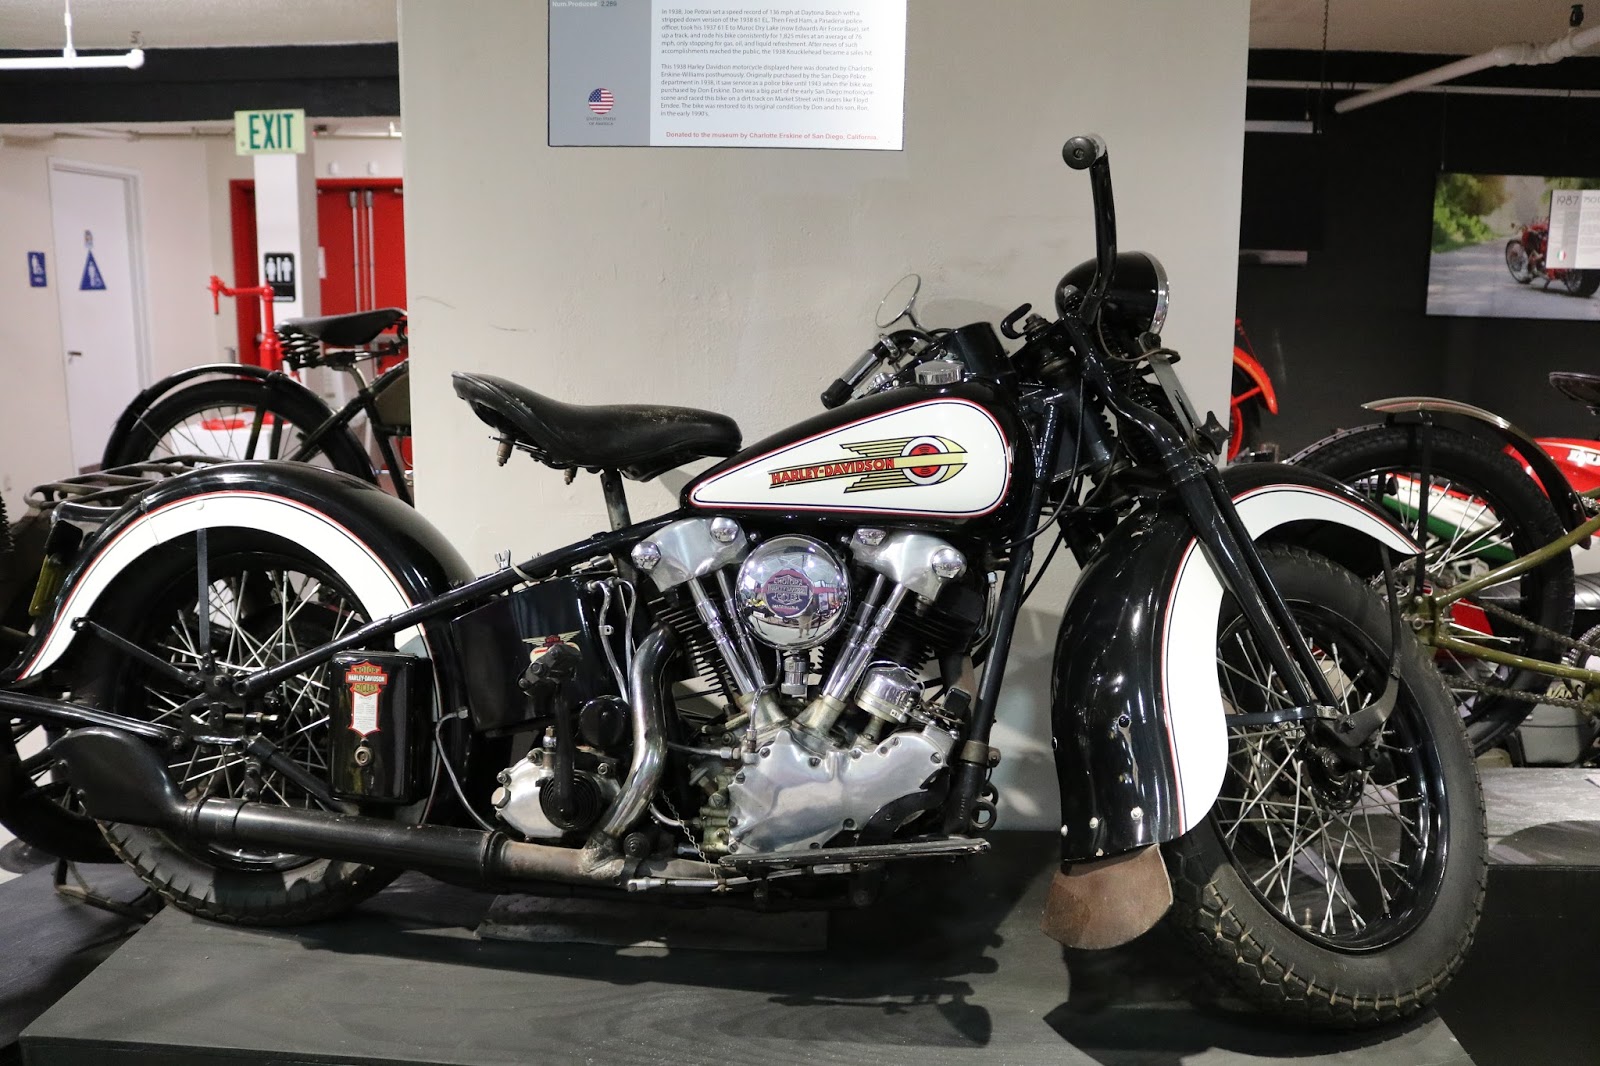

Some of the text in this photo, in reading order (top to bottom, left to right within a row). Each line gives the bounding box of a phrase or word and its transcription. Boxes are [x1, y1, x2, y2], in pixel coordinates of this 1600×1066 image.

[248, 114, 294, 149] EXIT
[1556, 195, 1579, 206] 1987
[770, 458, 895, 484] HARLEY-DAVIDSON
[356, 665, 377, 673] MOTOR
[348, 674, 385, 682] HARLEY-DAVIDSON
[356, 684, 376, 693] CYCLES
